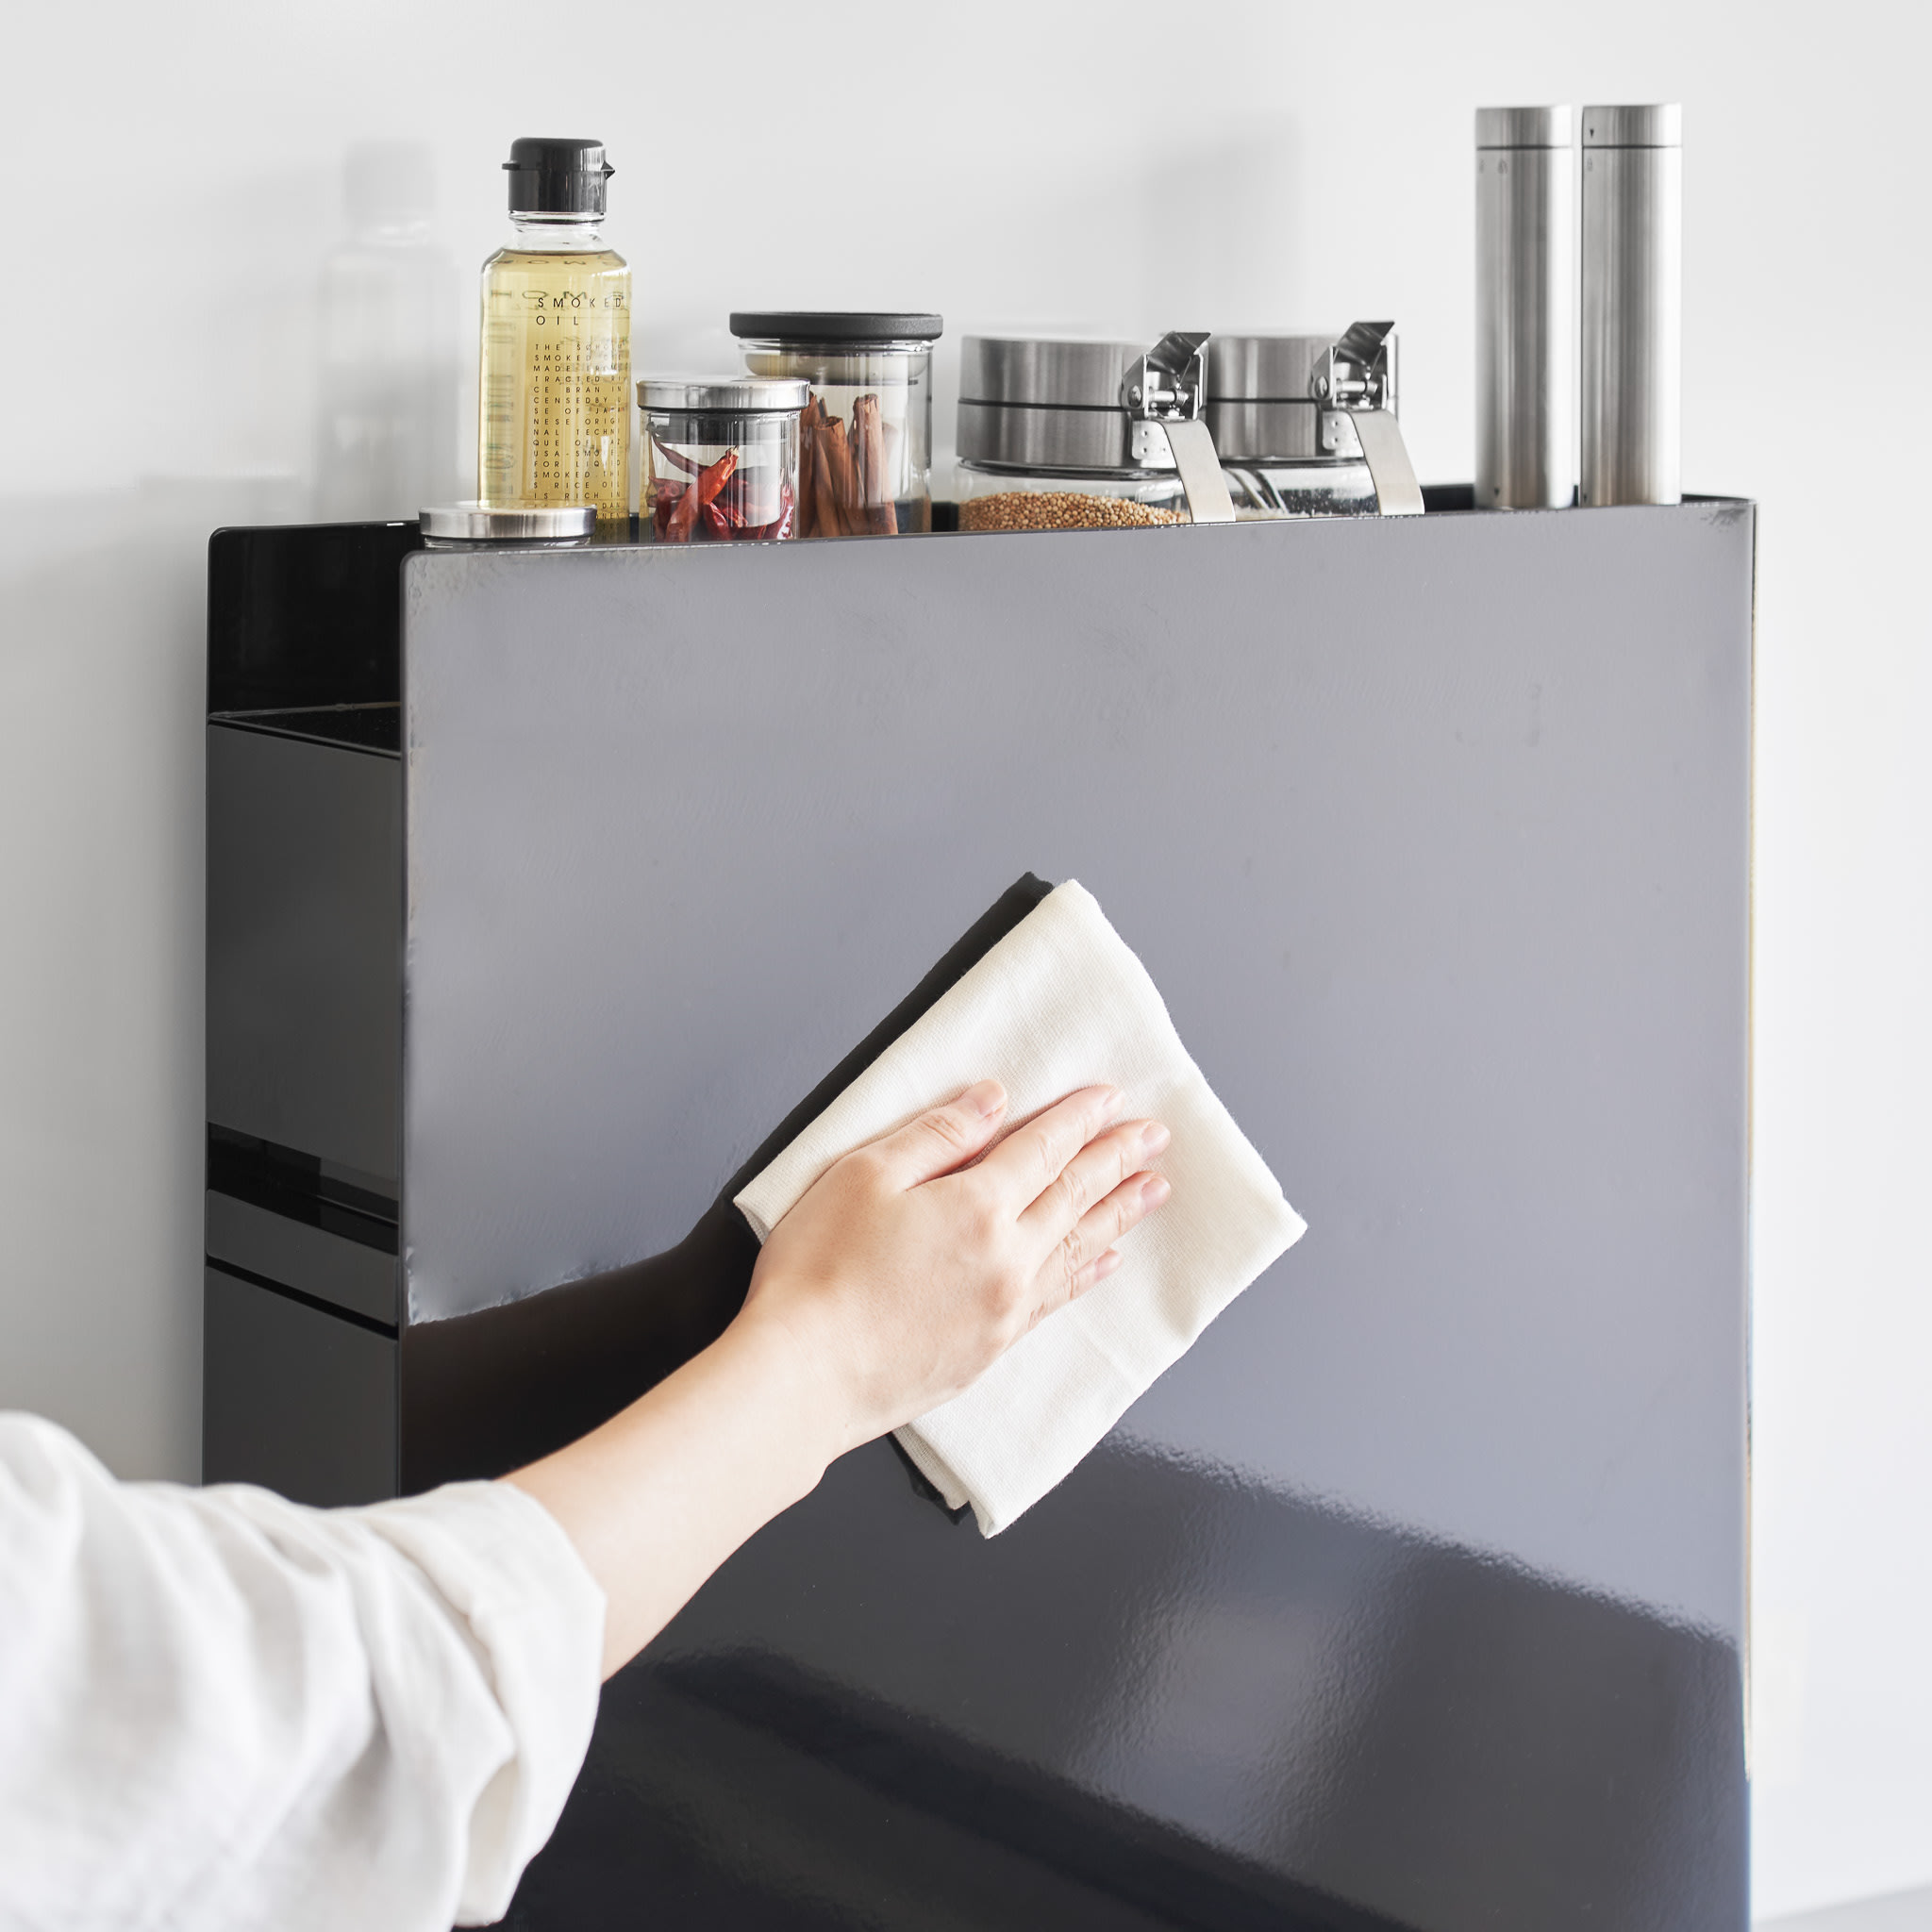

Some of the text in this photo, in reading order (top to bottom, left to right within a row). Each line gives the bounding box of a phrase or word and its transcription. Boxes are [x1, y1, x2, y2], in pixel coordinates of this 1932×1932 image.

[537, 297, 623, 308] SMOKED
[535, 315, 579, 325] OIL
[534, 354, 591, 362] SMOKED
[534, 375, 601, 384] TRACTED
[533, 386, 549, 394] CE
[565, 386, 601, 394] BRAN
[534, 408, 550, 416] SE
[533, 418, 570, 426] NESE
[533, 428, 559, 437] NAL
[532, 439, 559, 448] QUE
[575, 439, 590, 447] OF
[533, 460, 560, 469] FOR
[534, 492, 549, 501] IS
